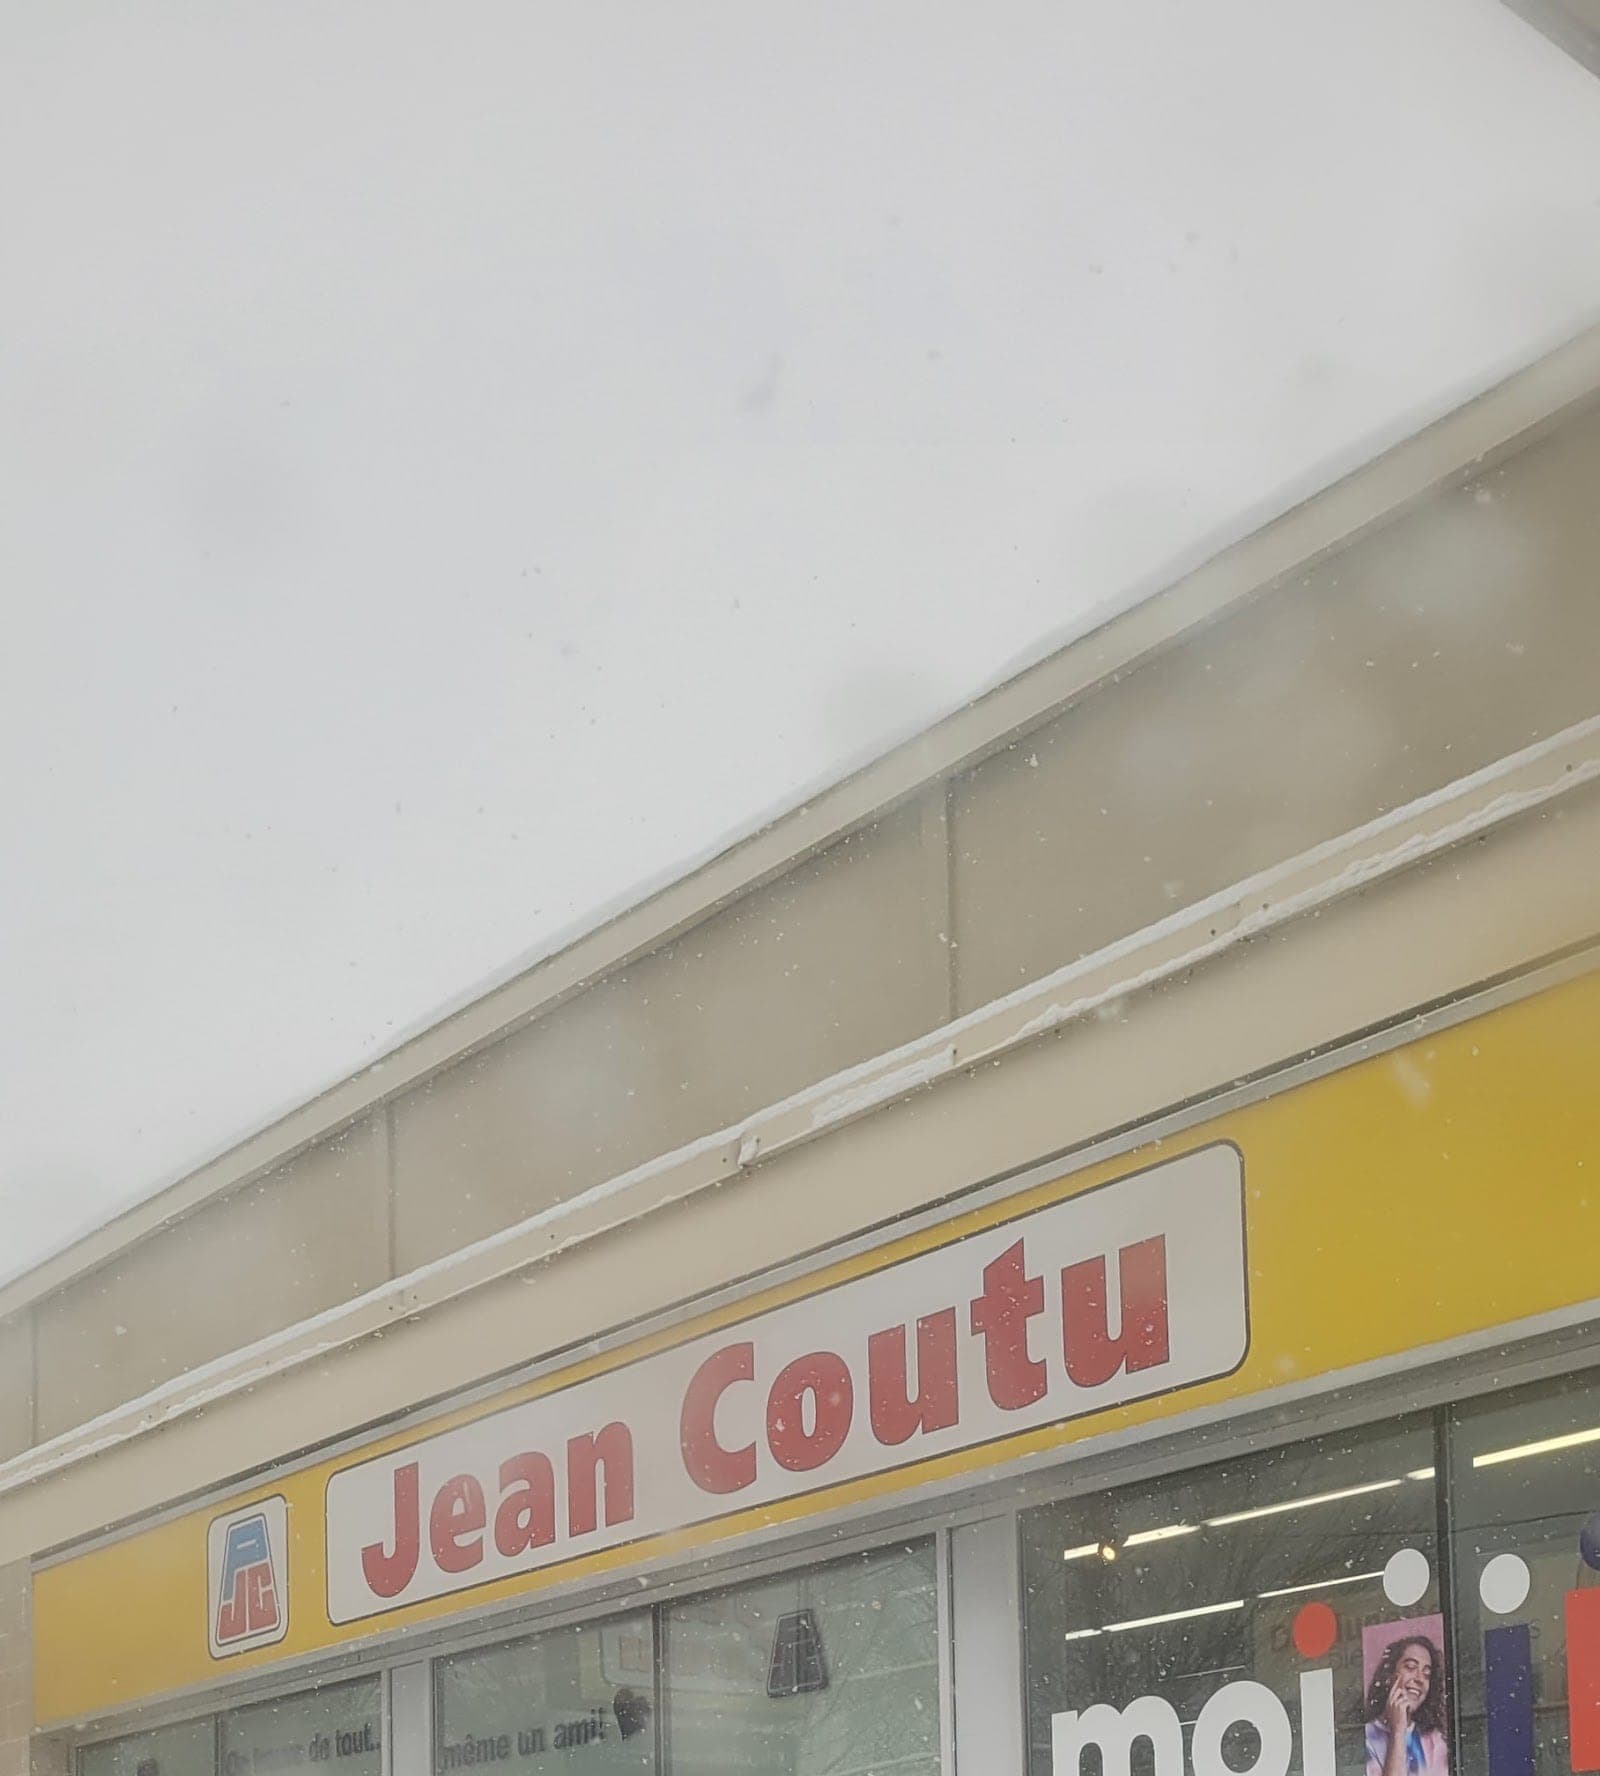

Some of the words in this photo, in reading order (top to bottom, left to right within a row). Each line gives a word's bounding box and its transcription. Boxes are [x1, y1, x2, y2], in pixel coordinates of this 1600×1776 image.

[361, 1421, 635, 1599] Jean
[680, 1232, 1171, 1495] Coutu
[443, 1733, 510, 1770] même
[517, 1727, 544, 1756] un
[554, 1707, 604, 1750] ami!
